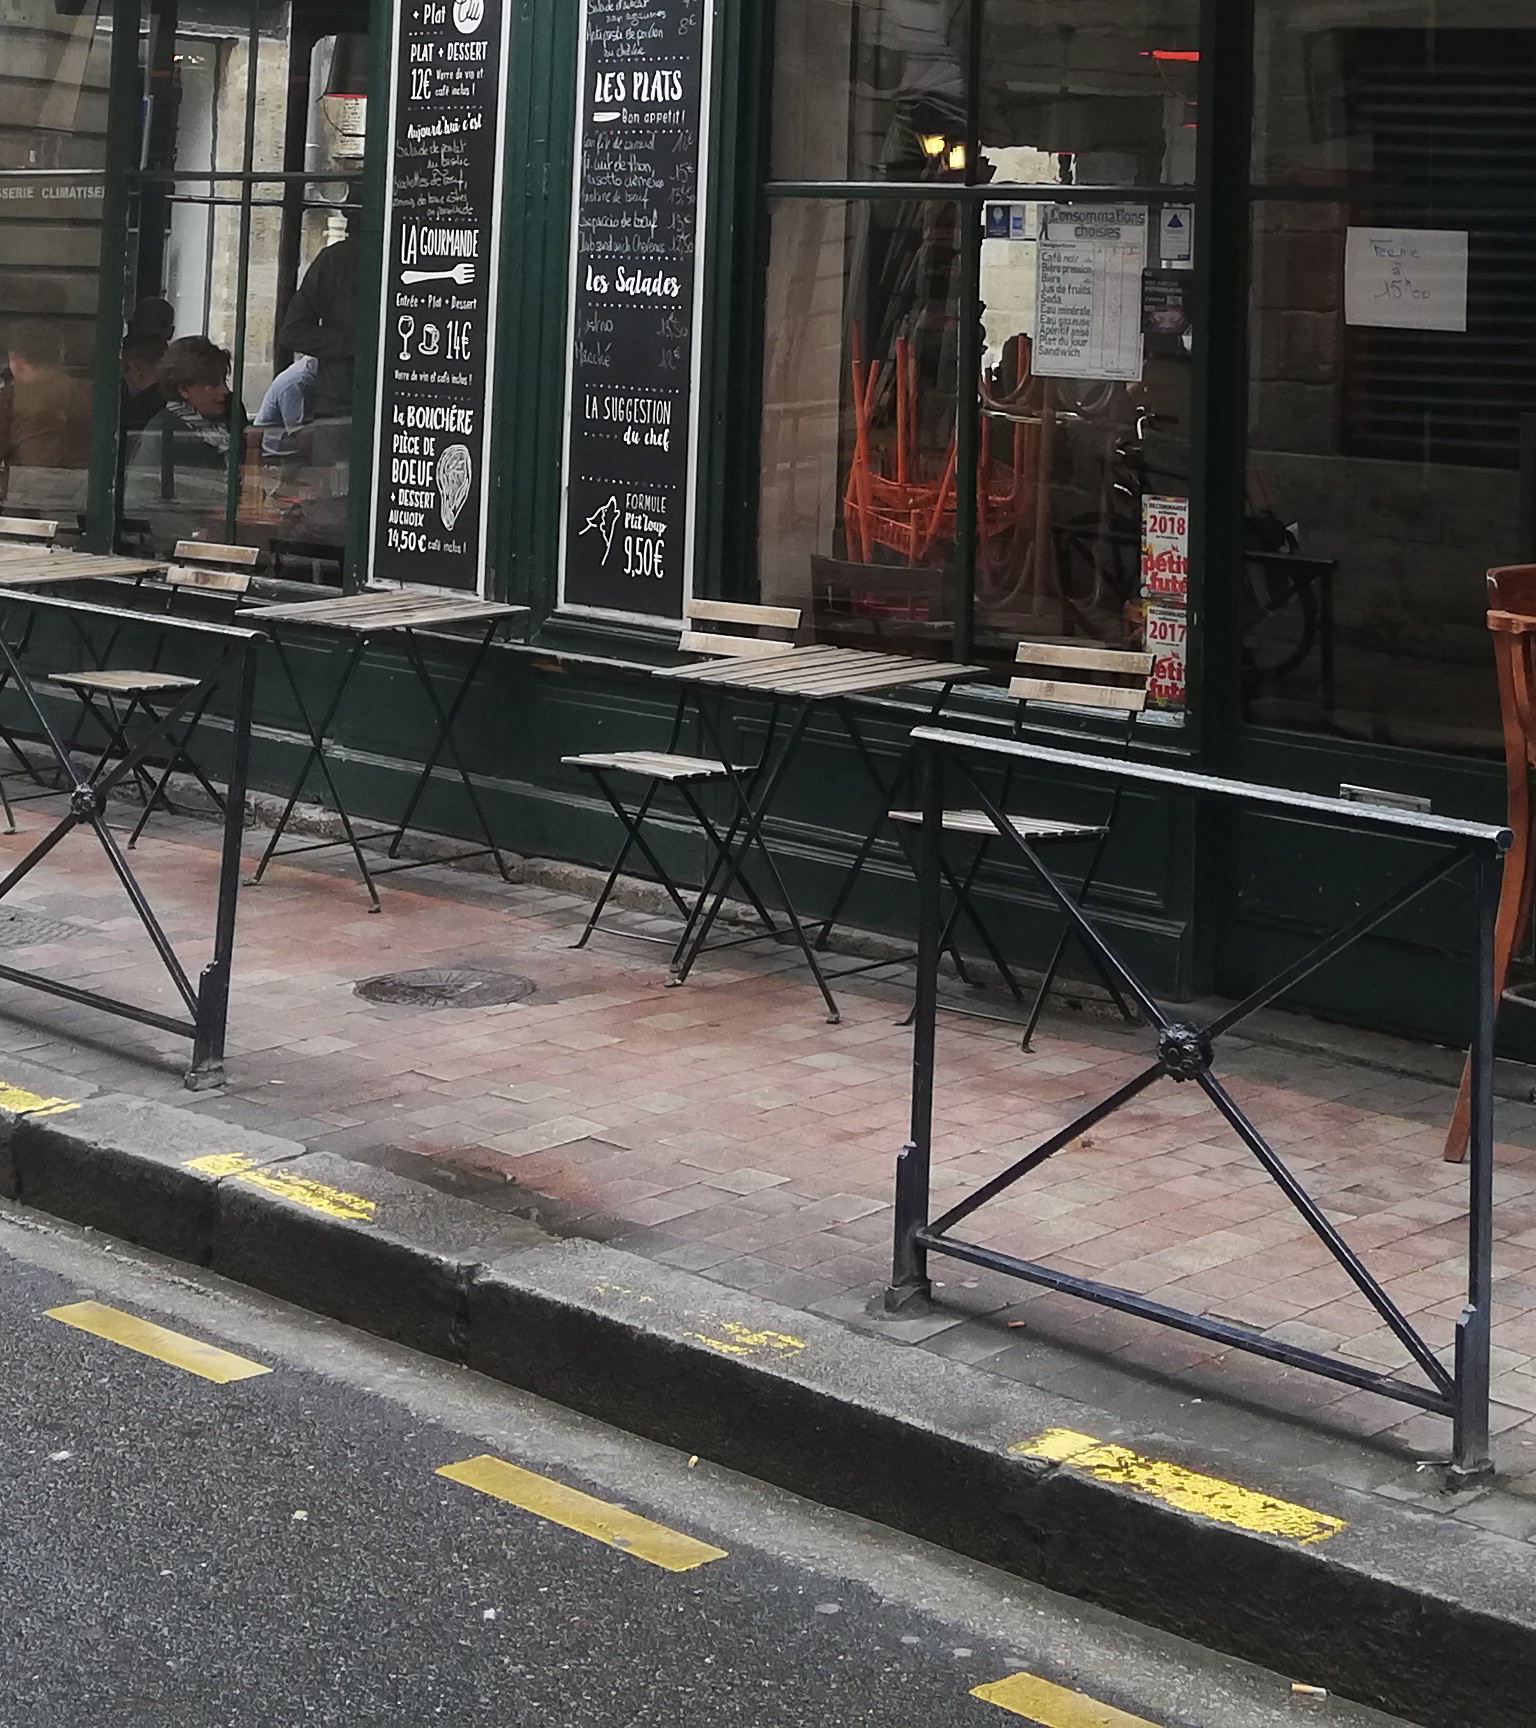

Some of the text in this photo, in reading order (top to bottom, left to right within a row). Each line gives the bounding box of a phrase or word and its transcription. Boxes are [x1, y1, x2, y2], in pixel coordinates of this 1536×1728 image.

[424, 2, 446, 25] Plat
[410, 41, 488, 62] PLAT DESSERT
[410, 68, 432, 100] 12€
[595, 69, 683, 103] LES PLATS
[622, 108, 640, 124] Bon
[1049, 207, 1145, 226] Consommations
[1074, 224, 1121, 240] choisies
[401, 223, 480, 265] LA GOURMANDE
[1041, 251, 1079, 263] Café noir
[615, 265, 682, 298] Salades
[1041, 283, 1092, 295] Jus de fruits
[396, 292, 477, 310] Entrée Plat Dessert
[1040, 294, 1062, 305] Soda
[1040, 304, 1056, 315] Eau
[1040, 315, 1057, 326] Eau
[445, 320, 472, 361] 14€
[1038, 345, 1081, 357] Sandwich
[1039, 335, 1088, 349] Plat du jour
[585, 394, 671, 425] LA SUGGESTION
[393, 429, 435, 456] PIÈCE DE
[623, 425, 670, 452] du chef
[391, 458, 434, 487] BOEUF
[398, 488, 436, 509] DESSERT
[625, 493, 667, 514] FORMULE
[1148, 514, 1186, 535] 2018
[623, 535, 665, 579] 9,50€
[1149, 620, 1188, 642] 2017
